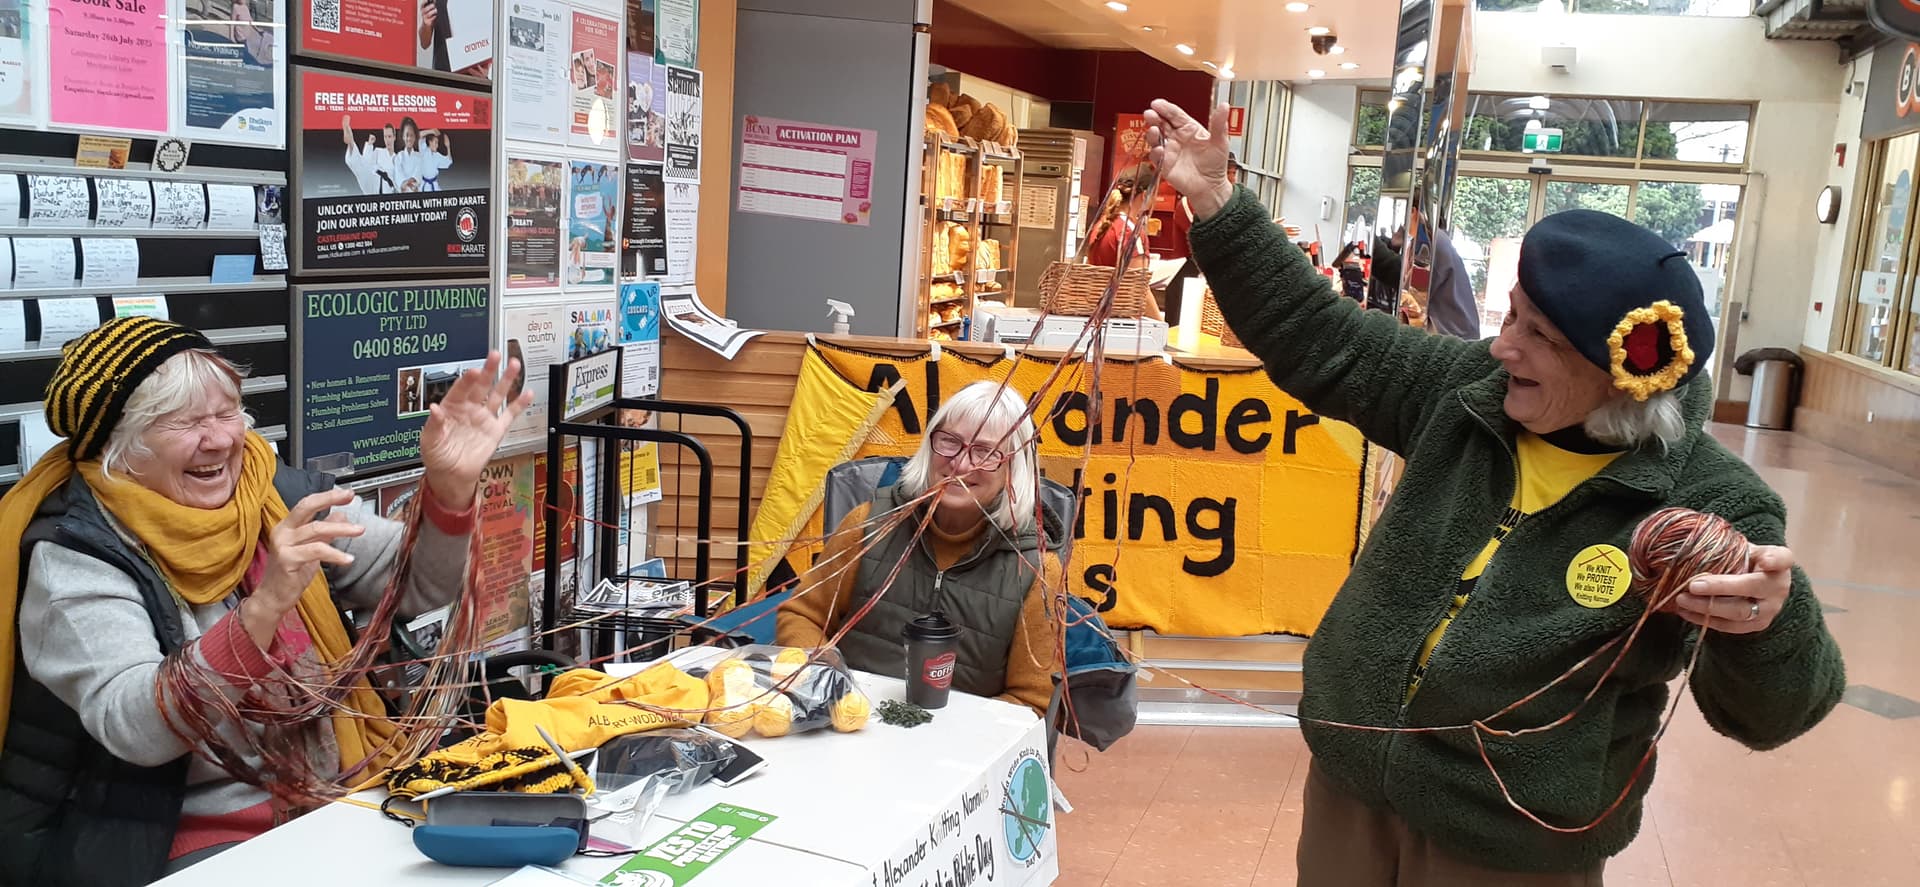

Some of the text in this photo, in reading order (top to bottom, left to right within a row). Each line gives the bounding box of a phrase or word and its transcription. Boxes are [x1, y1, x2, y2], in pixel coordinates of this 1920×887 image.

[115, 0, 146, 14] Sale
[64, 27, 99, 40] Saturday
[464, 38, 490, 53] aramex
[668, 78, 700, 98] SCHOOLS
[315, 92, 437, 108] FREE KARATE LESSONS
[779, 128, 833, 143] ACTIVATION
[836, 133, 858, 145] PLAN
[317, 195, 487, 216] UNLOCK YOUR POTENTIAL WITH RKD KARATE.
[316, 211, 448, 233] JOIN OUR KARATE FAMILY TODAY!
[317, 232, 362, 244] CASTLEMAINE
[307, 287, 488, 318] ECOLOGIC PLUMBING
[380, 314, 428, 332] PTY LTD
[570, 309, 612, 324] SALAMA
[544, 321, 553, 330] on
[353, 333, 448, 359] 0400 862 049
[528, 332, 556, 343] country
[311, 374, 391, 389] New homes & Renovations
[576, 364, 609, 389] Express
[311, 388, 379, 403] Plumbing Maintenance
[311, 398, 389, 417] Plumbing Problems Solved
[867, 361, 1320, 455] Alander
[310, 414, 373, 431] Site Soil Assessments
[480, 463, 514, 483] OWN
[480, 481, 510, 498] OLK
[483, 499, 514, 513] STIVAL
[1586, 564, 1612, 574] We KNIT
[1577, 573, 1617, 585] We PROTEST
[1575, 582, 1614, 595] We also VOTE
[1007, 757, 1020, 778] Wide
[1019, 746, 1030, 758] Knit
[644, 821, 718, 862] YES TO
[883, 838, 927, 887] Alexander
[928, 809, 961, 850] Knitting
[953, 844, 977, 887] Public
[975, 833, 995, 882] Day
[1025, 853, 1036, 868] DAY
